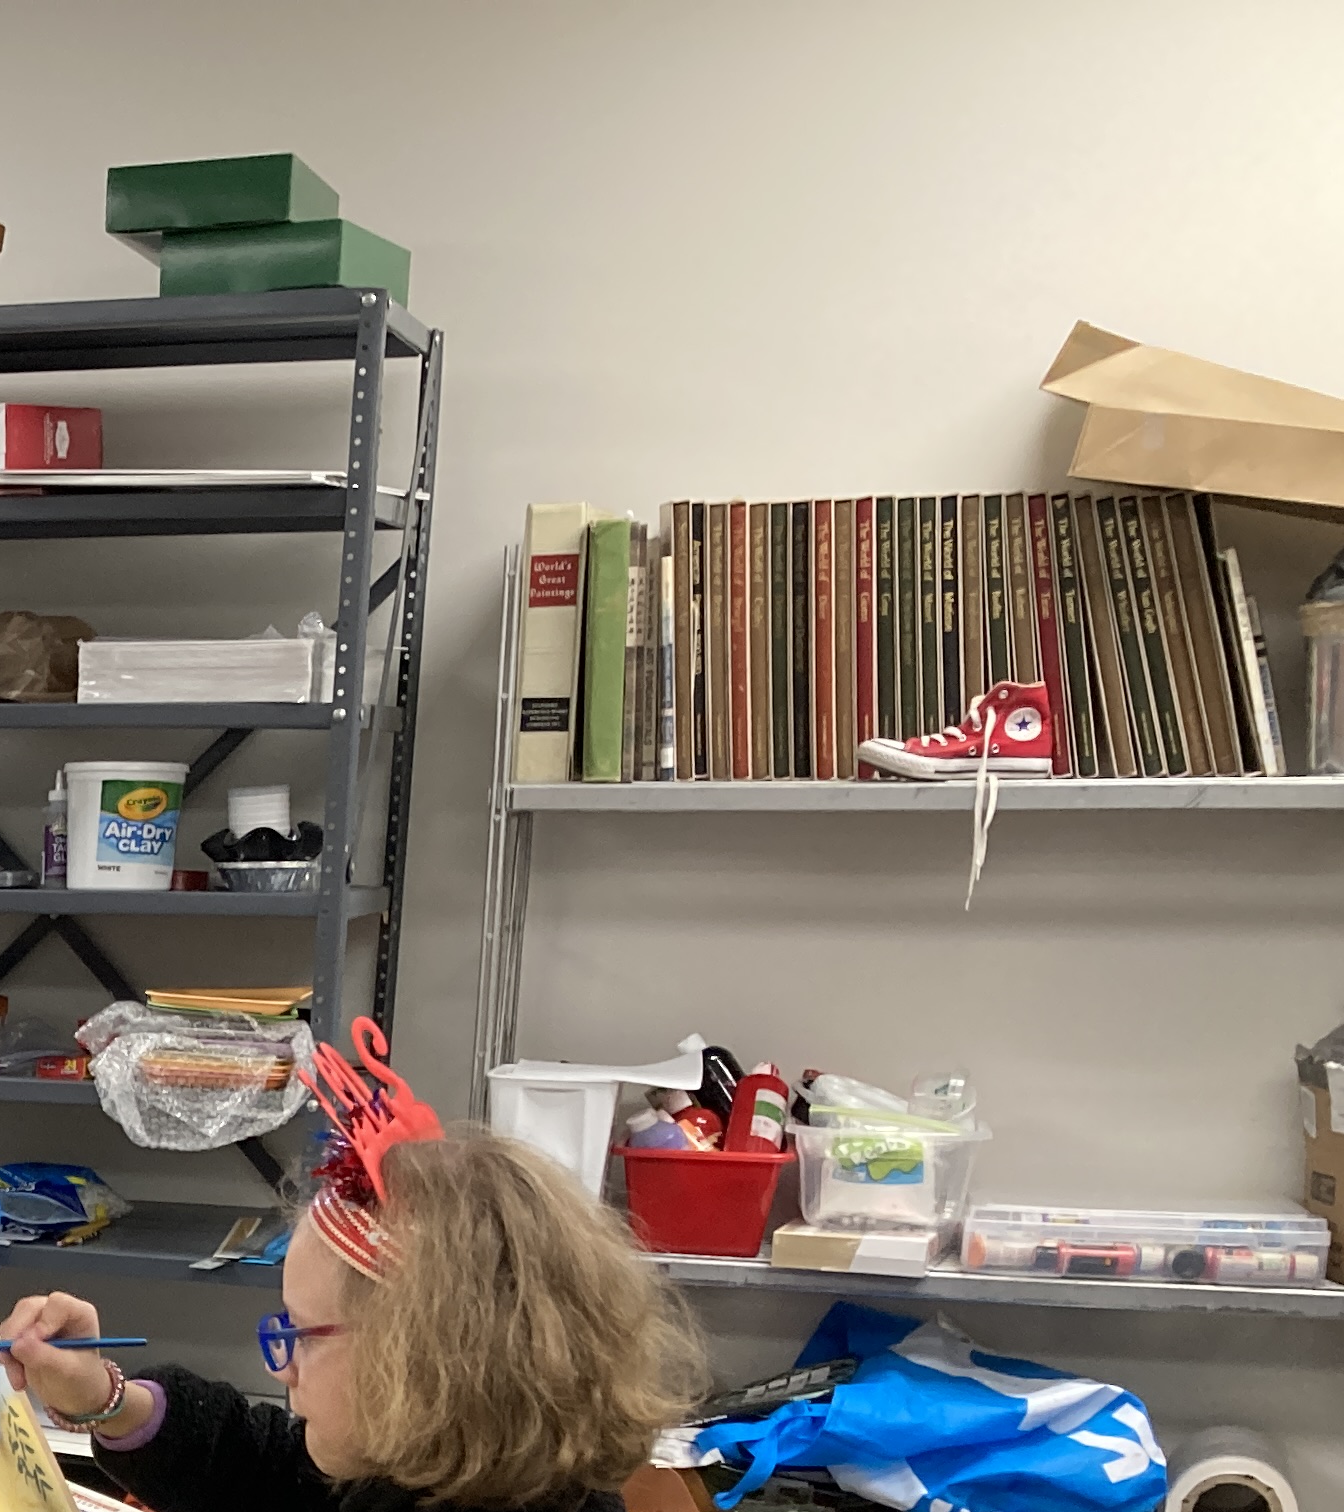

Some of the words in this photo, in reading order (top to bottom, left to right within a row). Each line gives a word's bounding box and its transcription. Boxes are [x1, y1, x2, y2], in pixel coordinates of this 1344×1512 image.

[880, 520, 891, 540] The
[923, 520, 933, 540] The
[943, 519, 954, 539] The
[989, 517, 1000, 538] The
[1058, 517, 1069, 537] The
[1105, 518, 1115, 538] The
[1127, 520, 1138, 539] The
[880, 540, 891, 568] World
[923, 541, 933, 569] World
[943, 539, 954, 569] World
[991, 539, 1001, 567] World
[1061, 538, 1073, 567] World
[1109, 539, 1121, 568] World
[1132, 539, 1145, 568] World
[534, 561, 571, 572] World's
[880, 569, 891, 580] of
[923, 571, 933, 581] of
[943, 570, 954, 580] of
[992, 568, 1002, 578] of
[1063, 567, 1073, 578] of
[1113, 569, 1123, 579] of
[1137, 568, 1148, 578] of
[538, 575, 566, 585] Great
[529, 588, 575, 600] Paintings
[105, 821, 174, 841] Air-Dry
[97, 864, 121, 873] WHITE
